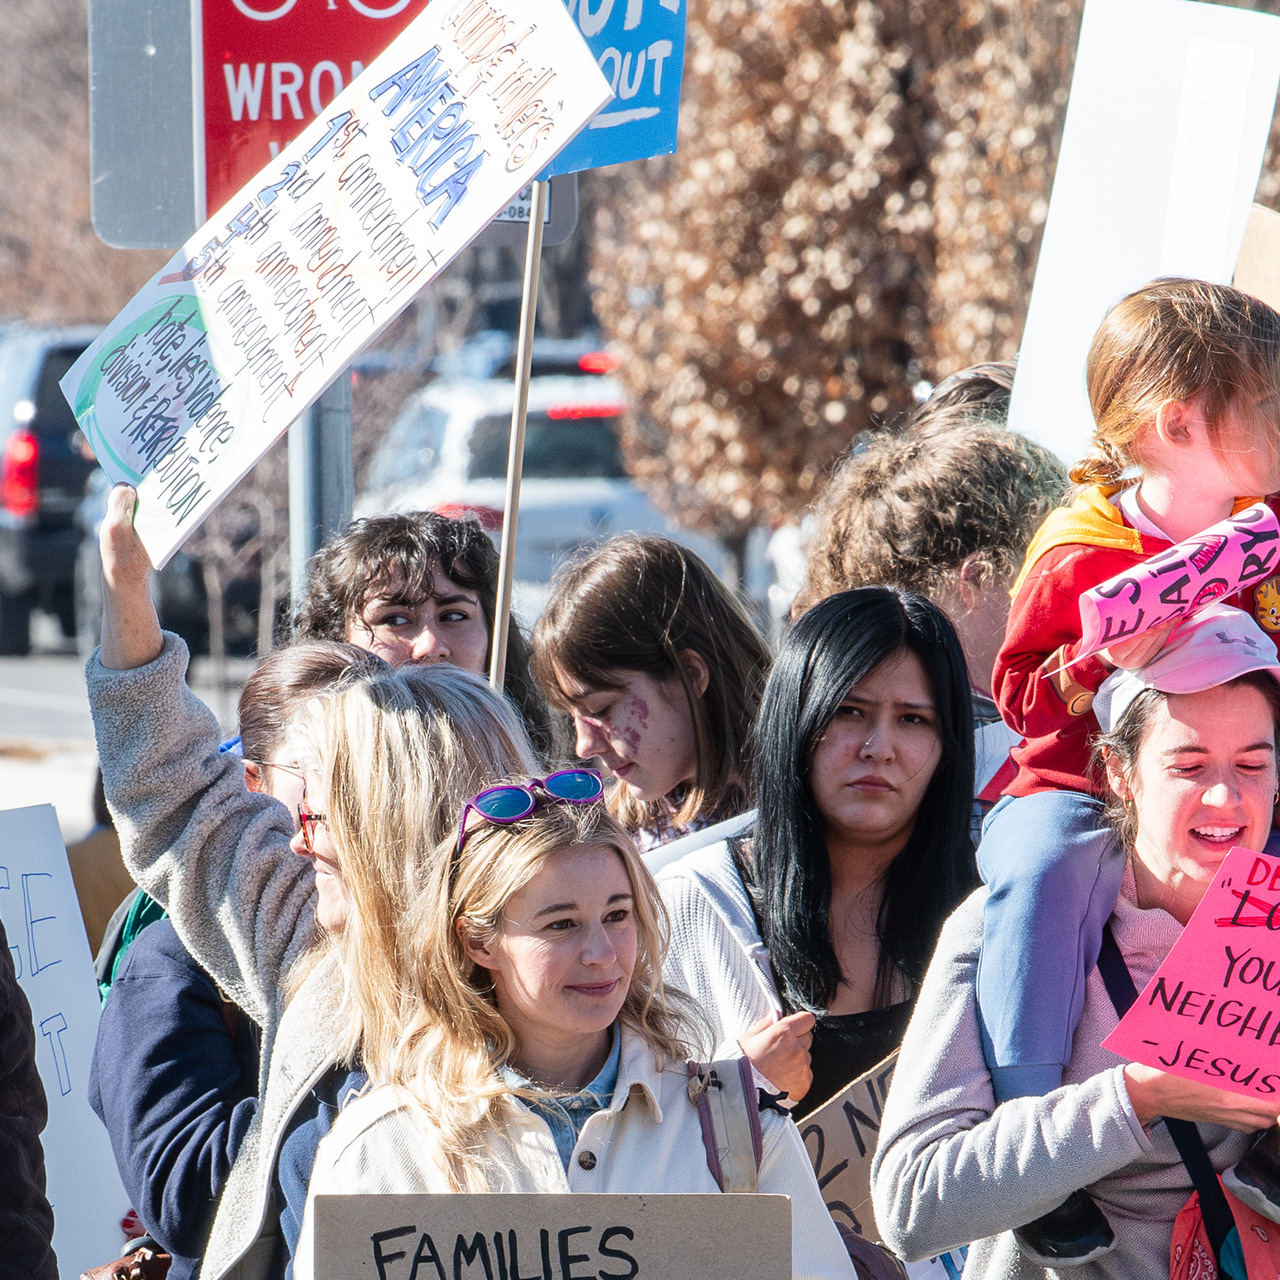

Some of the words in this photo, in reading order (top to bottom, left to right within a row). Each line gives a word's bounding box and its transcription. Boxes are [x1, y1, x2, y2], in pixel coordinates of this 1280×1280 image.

[597, 39, 673, 100] OUT
[257, 160, 326, 211] 2nd
[368, 44, 490, 234] AMERICA
[100, 333, 152, 414] division
[128, 397, 212, 528] RETRIBUTION
